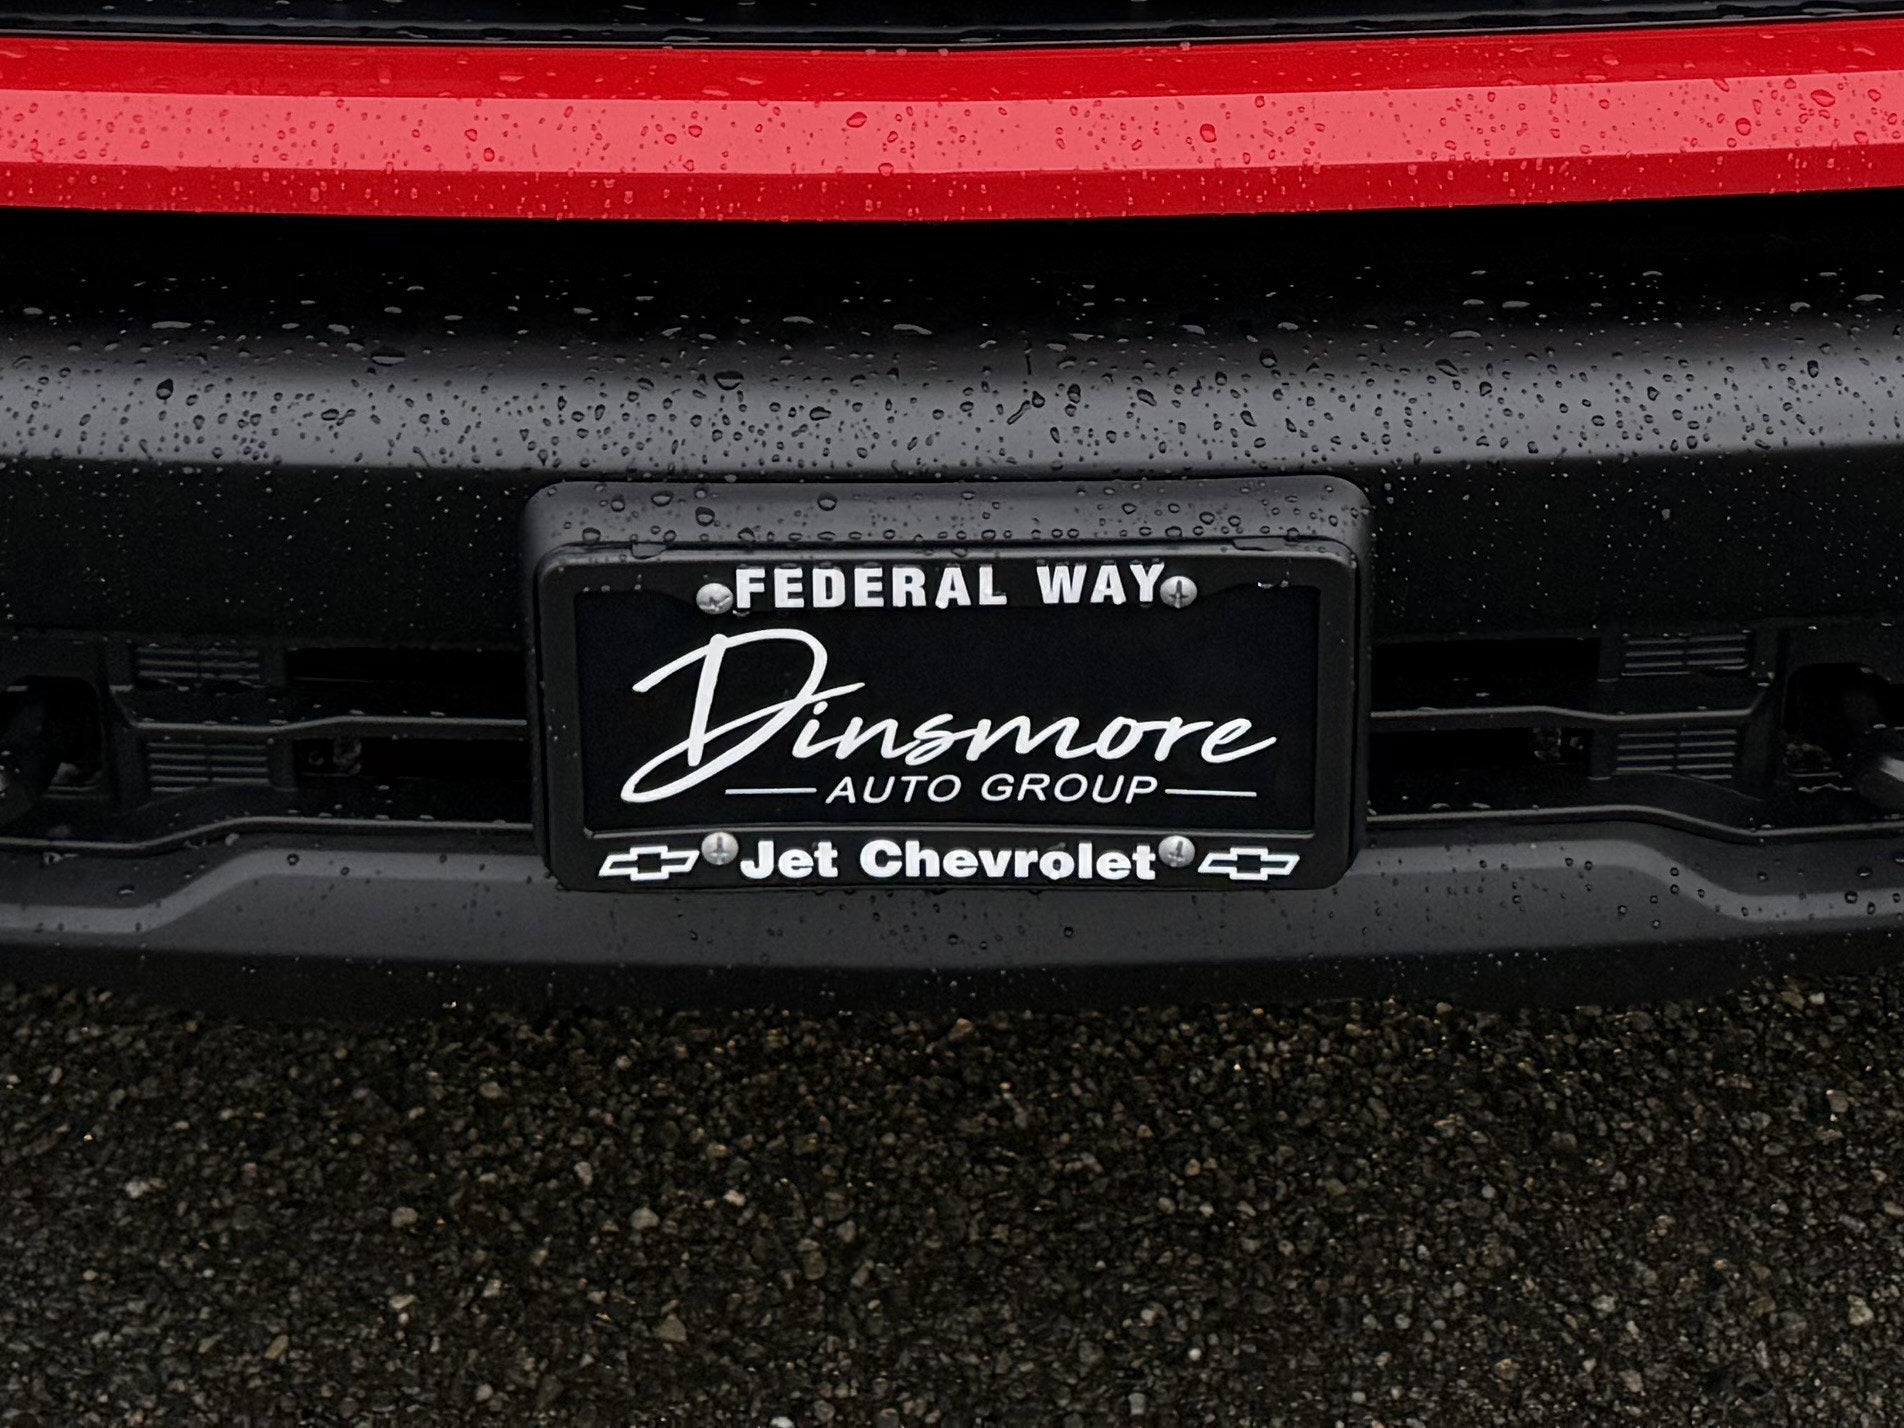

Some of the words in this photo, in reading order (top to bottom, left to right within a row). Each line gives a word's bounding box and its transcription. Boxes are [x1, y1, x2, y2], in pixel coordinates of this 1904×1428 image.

[735, 564, 1008, 610] FEDERAL
[1036, 561, 1165, 605] WAY
[620, 628, 1277, 804] Dinsmore
[824, 774, 962, 804] AUTO
[980, 772, 1158, 804] GROUP
[739, 839, 839, 880] Jet
[859, 838, 1156, 881] Chevrolet
